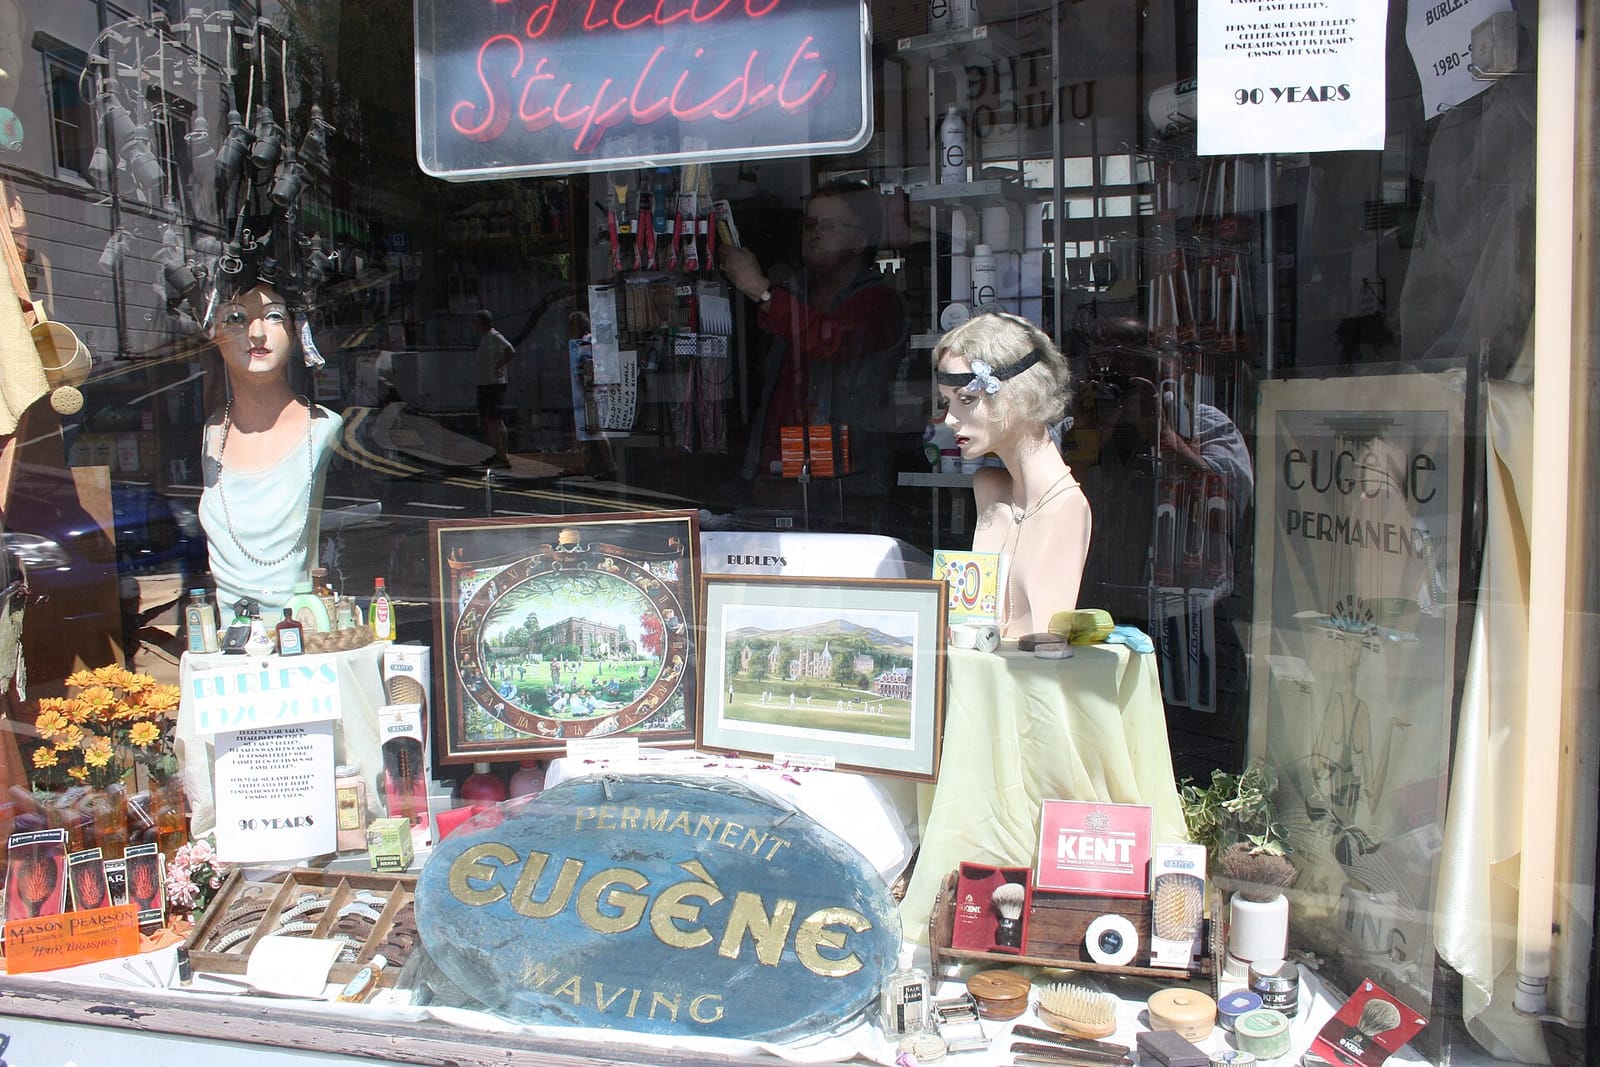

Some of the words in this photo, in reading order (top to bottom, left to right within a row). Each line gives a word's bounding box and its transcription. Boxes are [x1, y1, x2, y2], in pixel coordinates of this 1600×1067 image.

[451, 34, 828, 152] Stylist
[1234, 88, 1264, 105] 90
[1269, 84, 1351, 104] YEARS
[727, 554, 788, 567] BURLEYS
[193, 662, 337, 699] BURLEYS
[238, 818, 257, 831] 90
[260, 815, 314, 830] YEARS
[575, 805, 793, 862] PERMANENT
[1057, 834, 1136, 863] KENT
[447, 841, 874, 978] EUGÈNE
[10, 921, 64, 946] MASON
[68, 911, 134, 937] PEARSON
[518, 956, 726, 1025] WAVING
[1343, 1041, 1365, 1056] KENT
